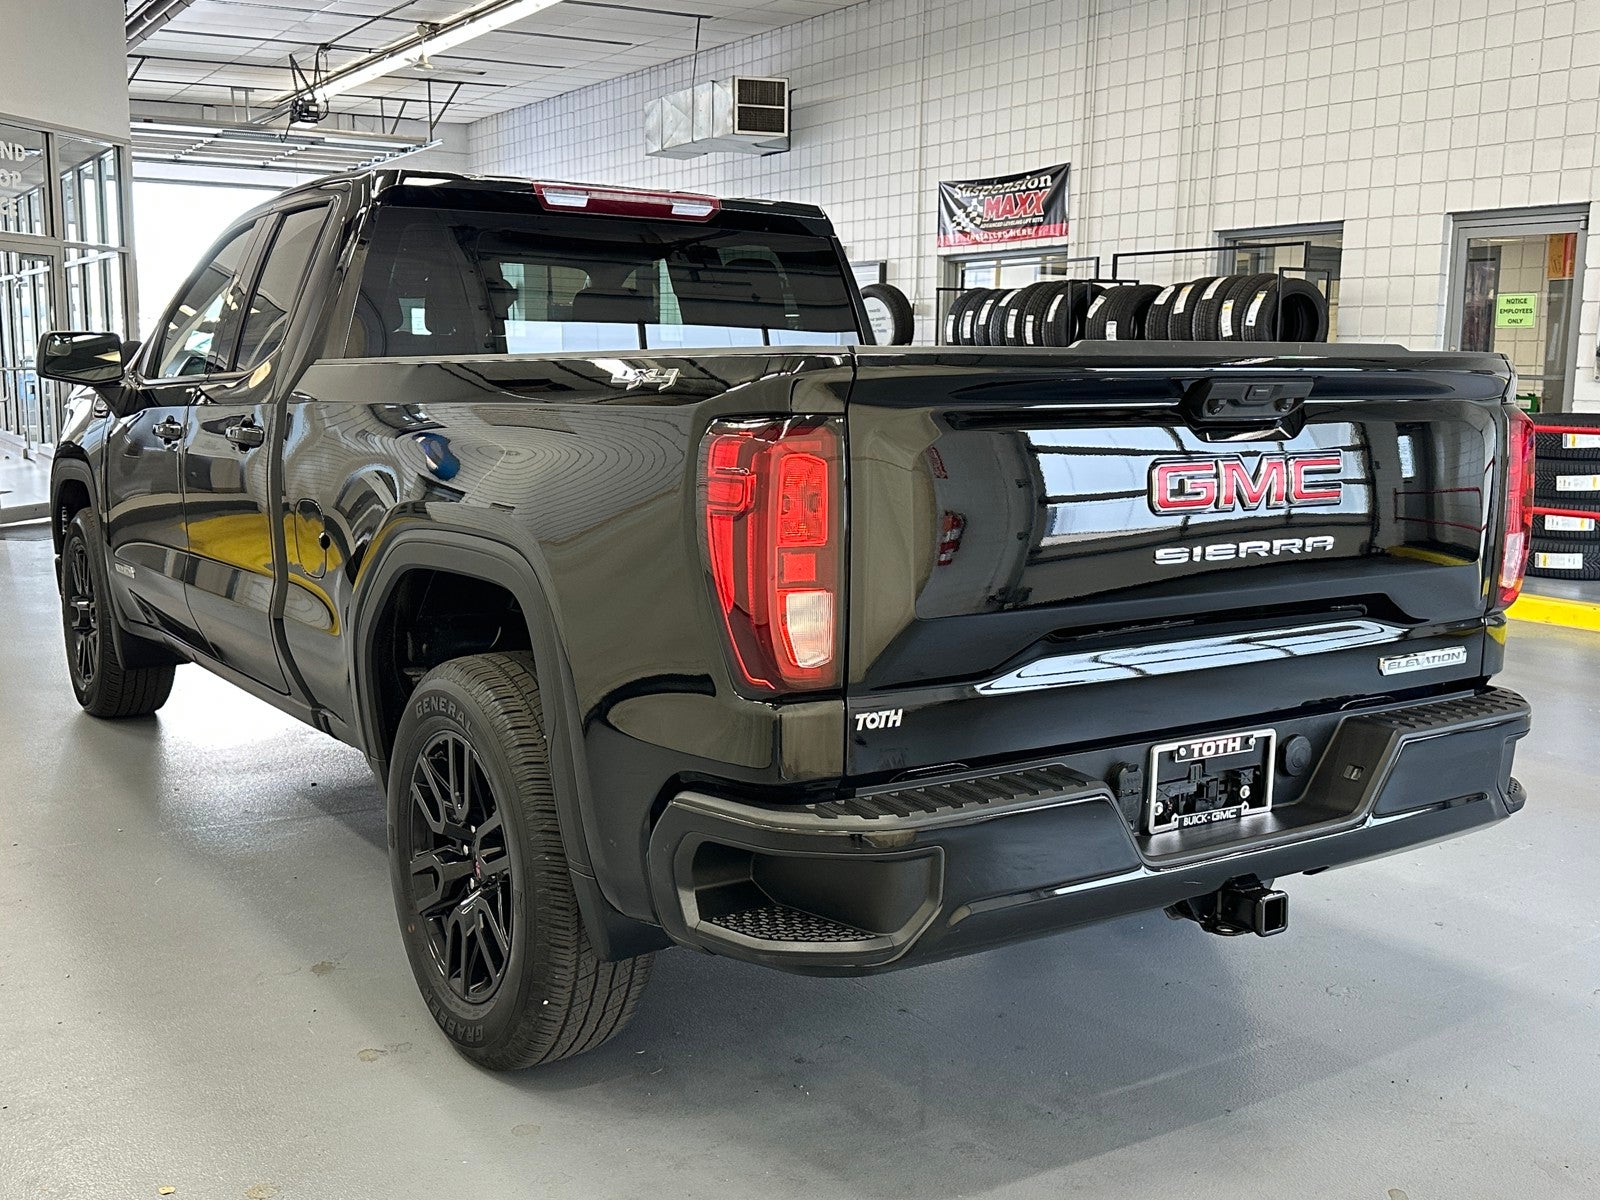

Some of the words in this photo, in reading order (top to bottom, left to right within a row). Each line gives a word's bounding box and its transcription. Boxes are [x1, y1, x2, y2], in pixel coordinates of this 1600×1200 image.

[953, 174, 1053, 200] Suspension
[983, 188, 1051, 221] MAXX
[1148, 449, 1343, 516] GMC
[1154, 535, 1335, 565] SIERRA
[1387, 651, 1461, 671] ELEVATION
[415, 696, 474, 737] GENERAL
[855, 708, 903, 731] TOTH
[1190, 737, 1241, 758] TOTH
